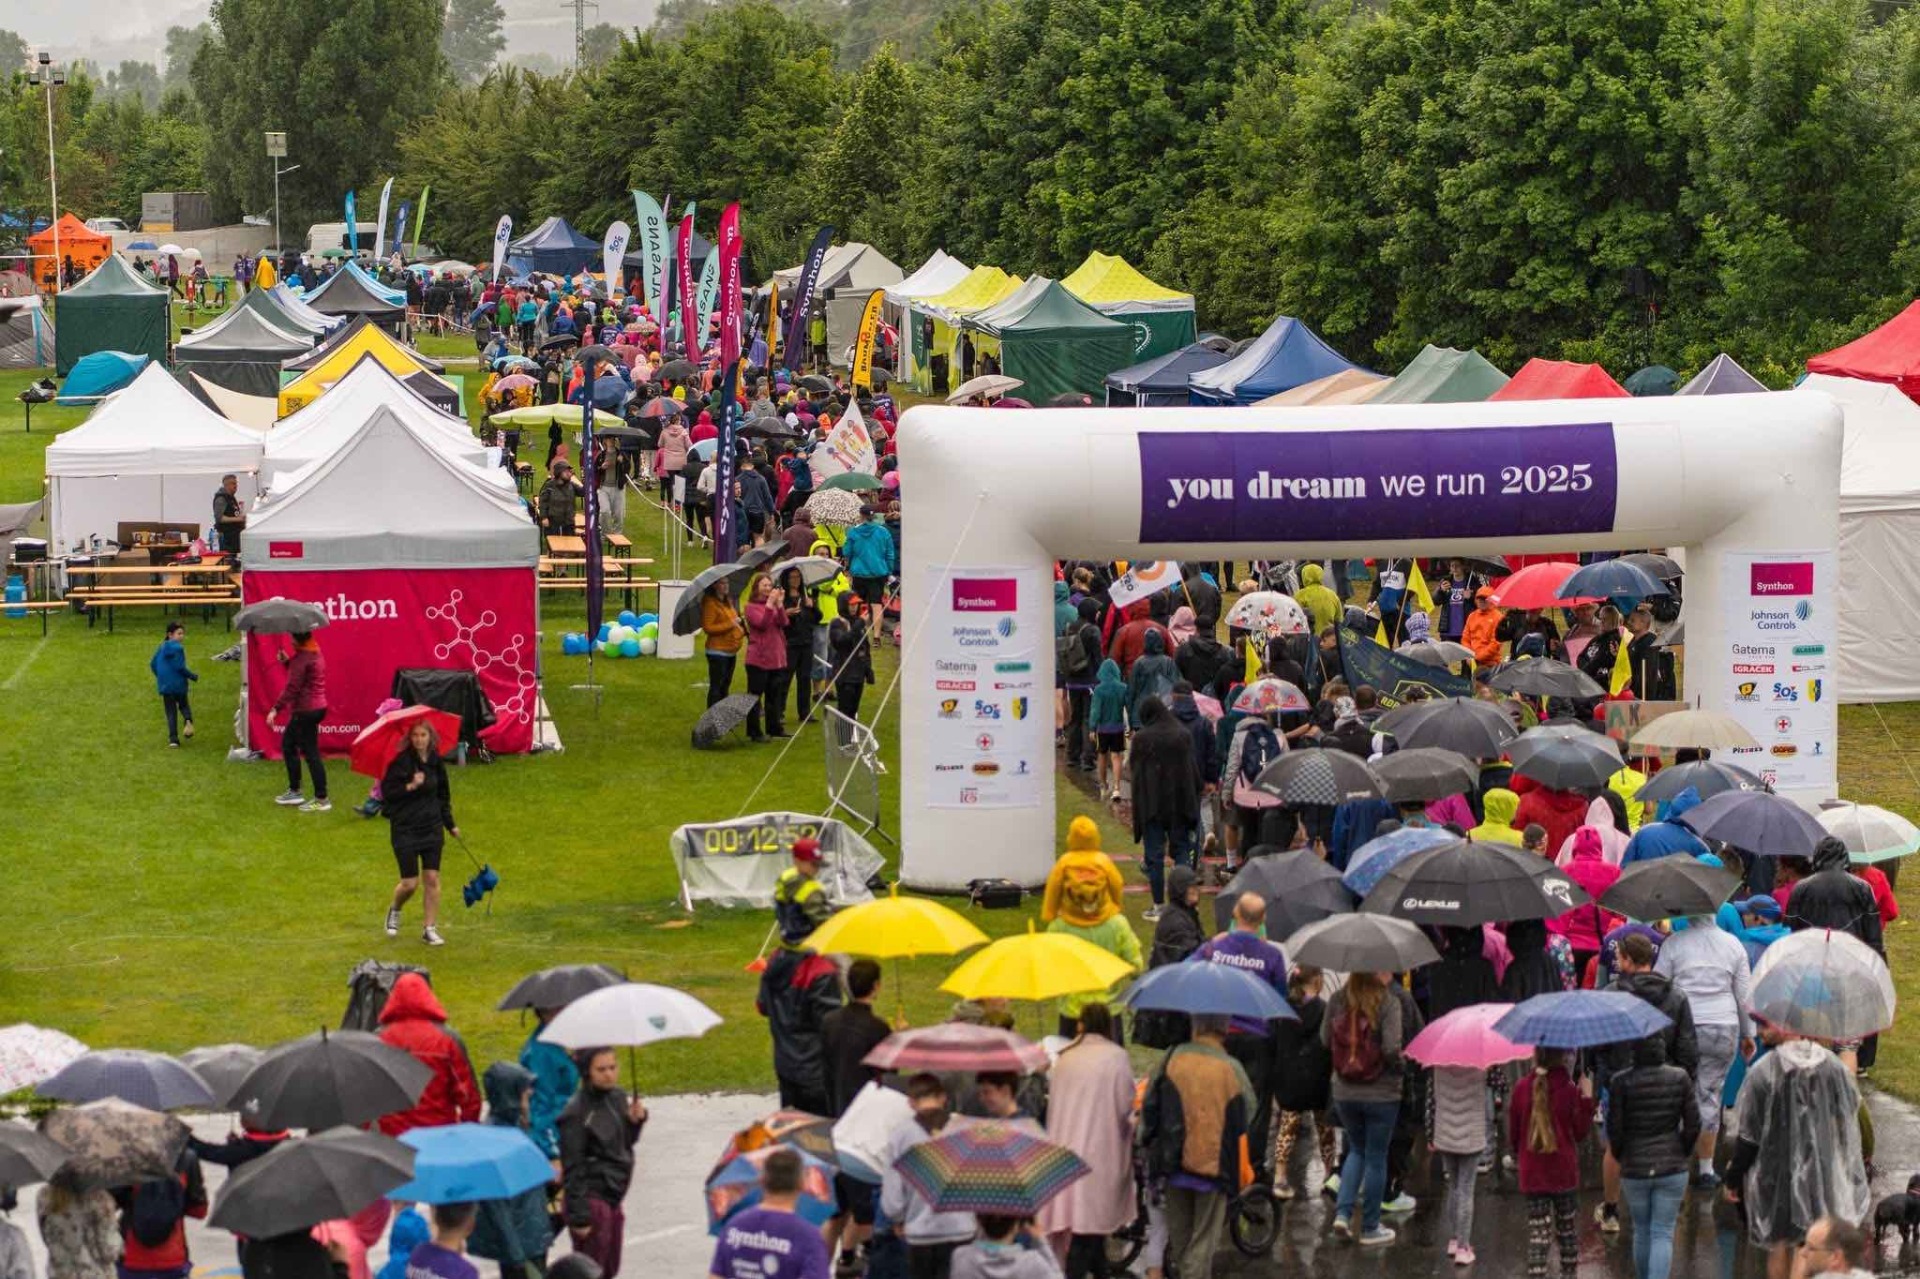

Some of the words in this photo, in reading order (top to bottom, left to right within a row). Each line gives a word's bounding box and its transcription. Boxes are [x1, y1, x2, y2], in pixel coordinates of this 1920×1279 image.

[801, 248, 823, 318] Synthon
[1168, 476, 1234, 508] you
[1247, 471, 1366, 500] dream
[1381, 473, 1426, 498] we
[1437, 471, 1485, 497] run
[1501, 463, 1593, 495] 2025
[1756, 581, 1794, 592] Synthon
[958, 597, 997, 608] Synthon
[1751, 610, 1789, 621] Johnson
[1757, 620, 1796, 630] Controls
[952, 626, 991, 637] Johnson
[959, 637, 999, 646] Controls
[1732, 644, 1775, 655] Gatema
[935, 660, 977, 671] Gatema
[1773, 682, 1798, 702] SOS
[975, 699, 1001, 719] SOS
[1418, 900, 1461, 909] LEXUS
[1213, 950, 1265, 969] Synthon
[726, 1227, 793, 1255] Synthon
